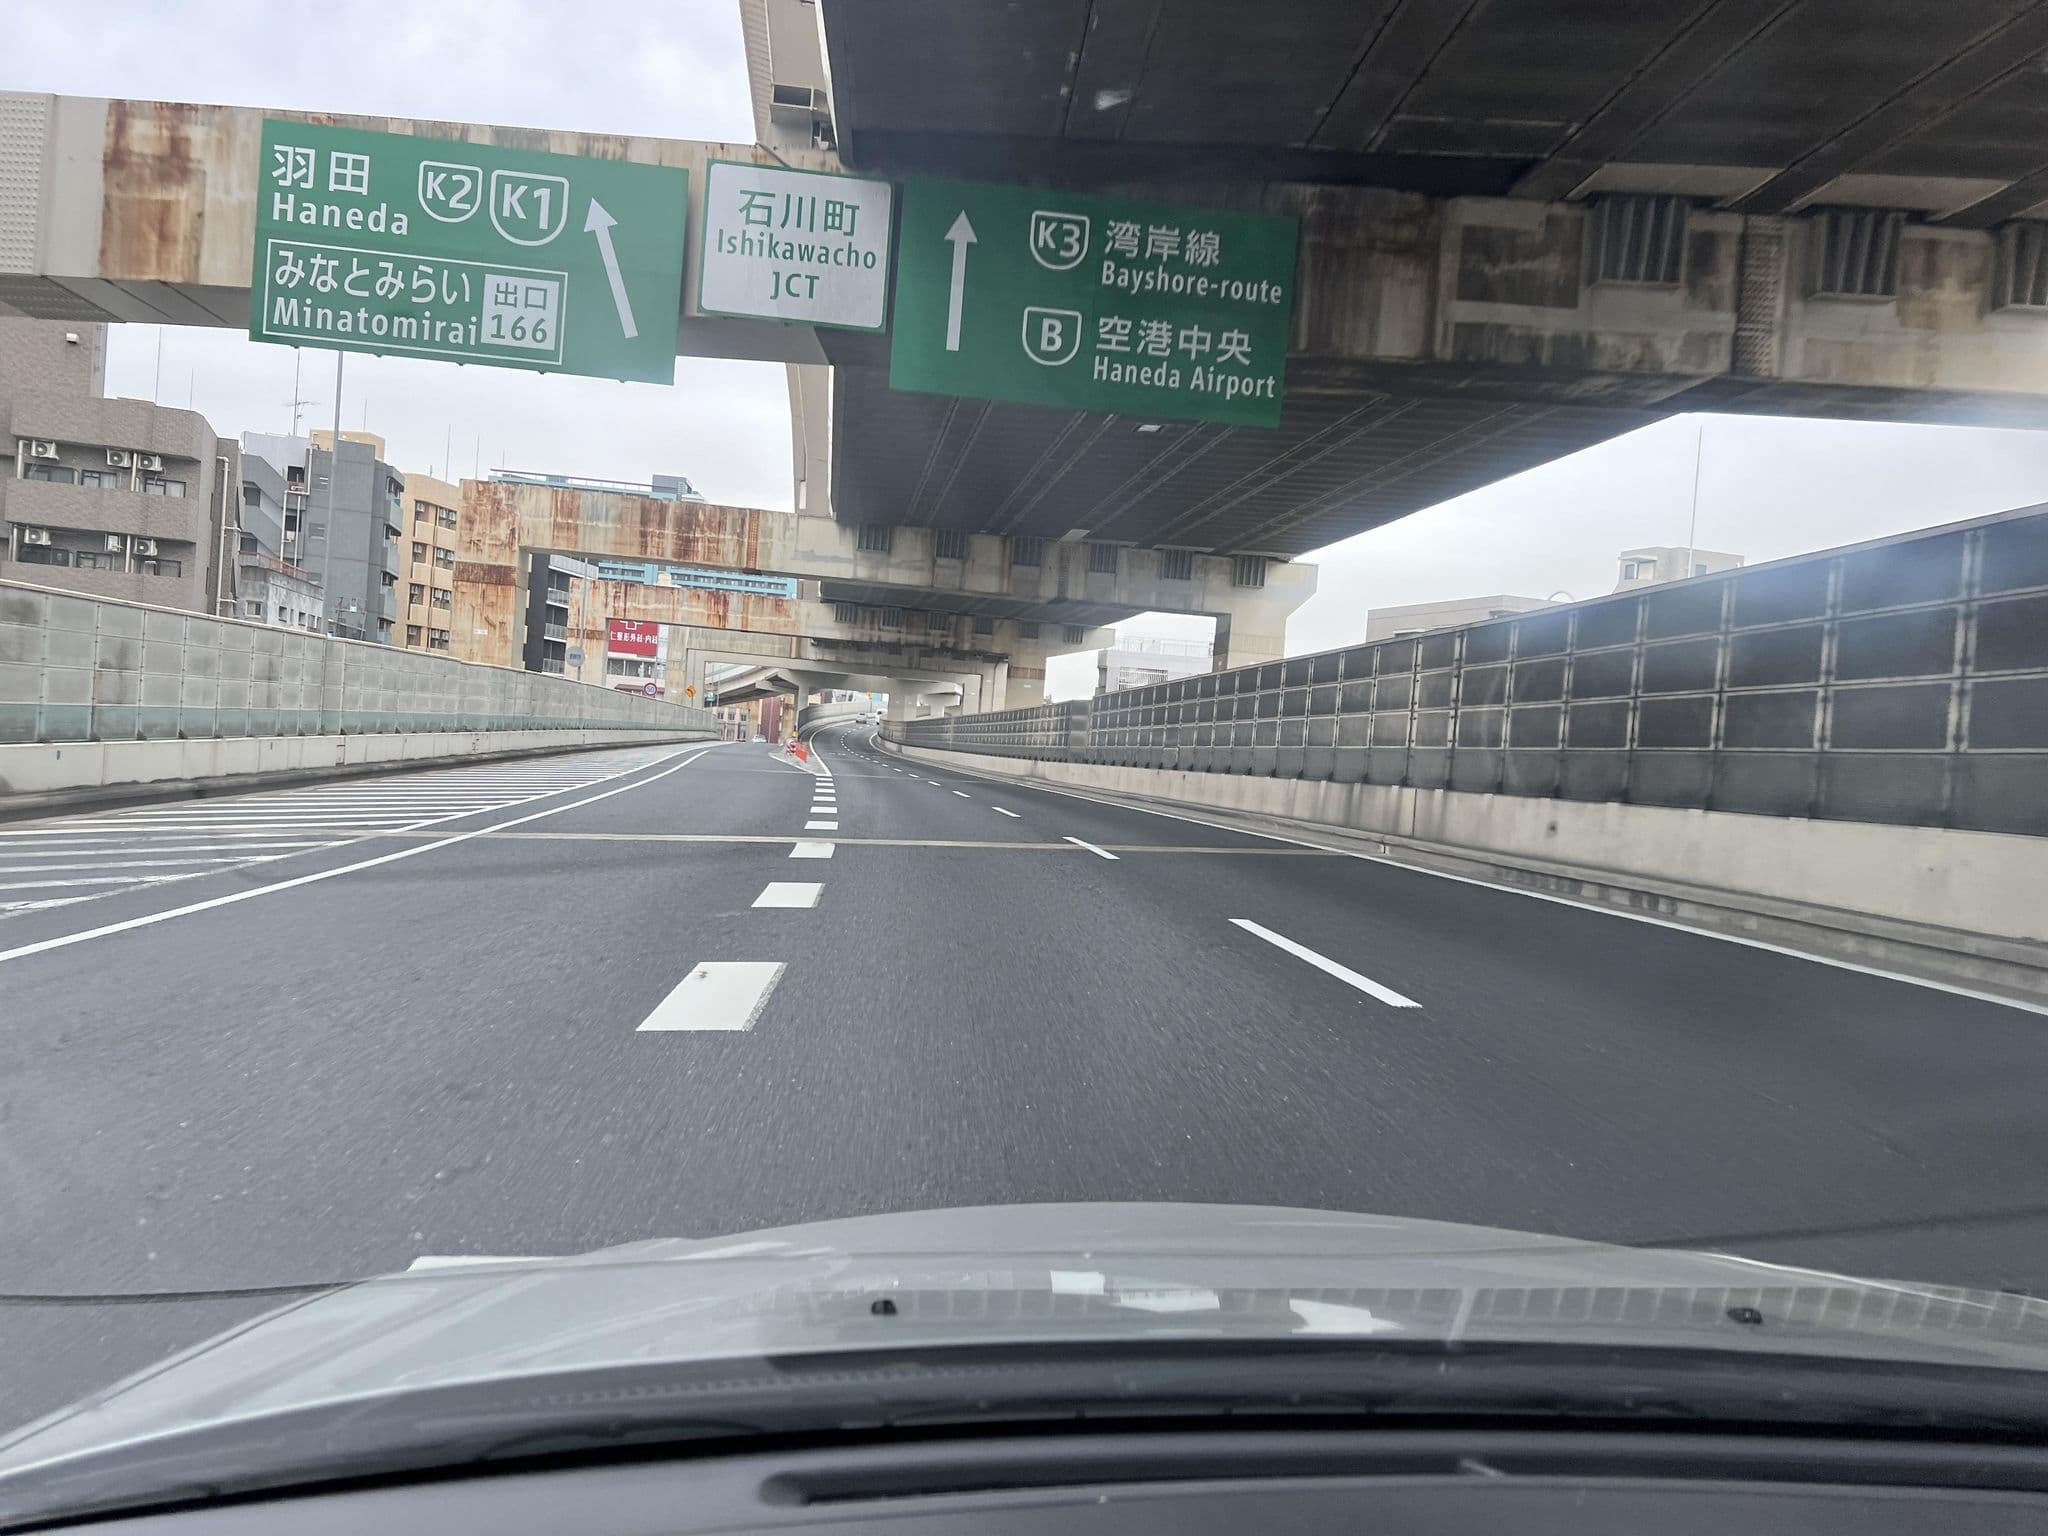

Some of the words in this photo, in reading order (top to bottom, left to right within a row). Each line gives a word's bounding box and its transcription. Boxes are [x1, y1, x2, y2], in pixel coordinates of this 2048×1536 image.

[271, 144, 370, 196] 羽田
[426, 171, 472, 210] K2
[272, 192, 409, 236] Haneda
[502, 183, 552, 230] K1
[738, 188, 860, 237] 石川町
[717, 228, 877, 270] Ishikawacho
[1037, 222, 1081, 259] K3
[1104, 220, 1222, 268] 湾岸線
[274, 250, 471, 305] みなとみらい
[494, 281, 547, 311] 出口
[769, 272, 820, 300] JCT
[1101, 261, 1282, 304] Bayshore-route
[273, 296, 478, 346] Minatomirai
[490, 313, 548, 344] 166
[1041, 318, 1063, 352] B
[1096, 315, 1252, 366] 空港中央
[1093, 355, 1181, 389] Haneda
[1190, 367, 1276, 400] Airport
